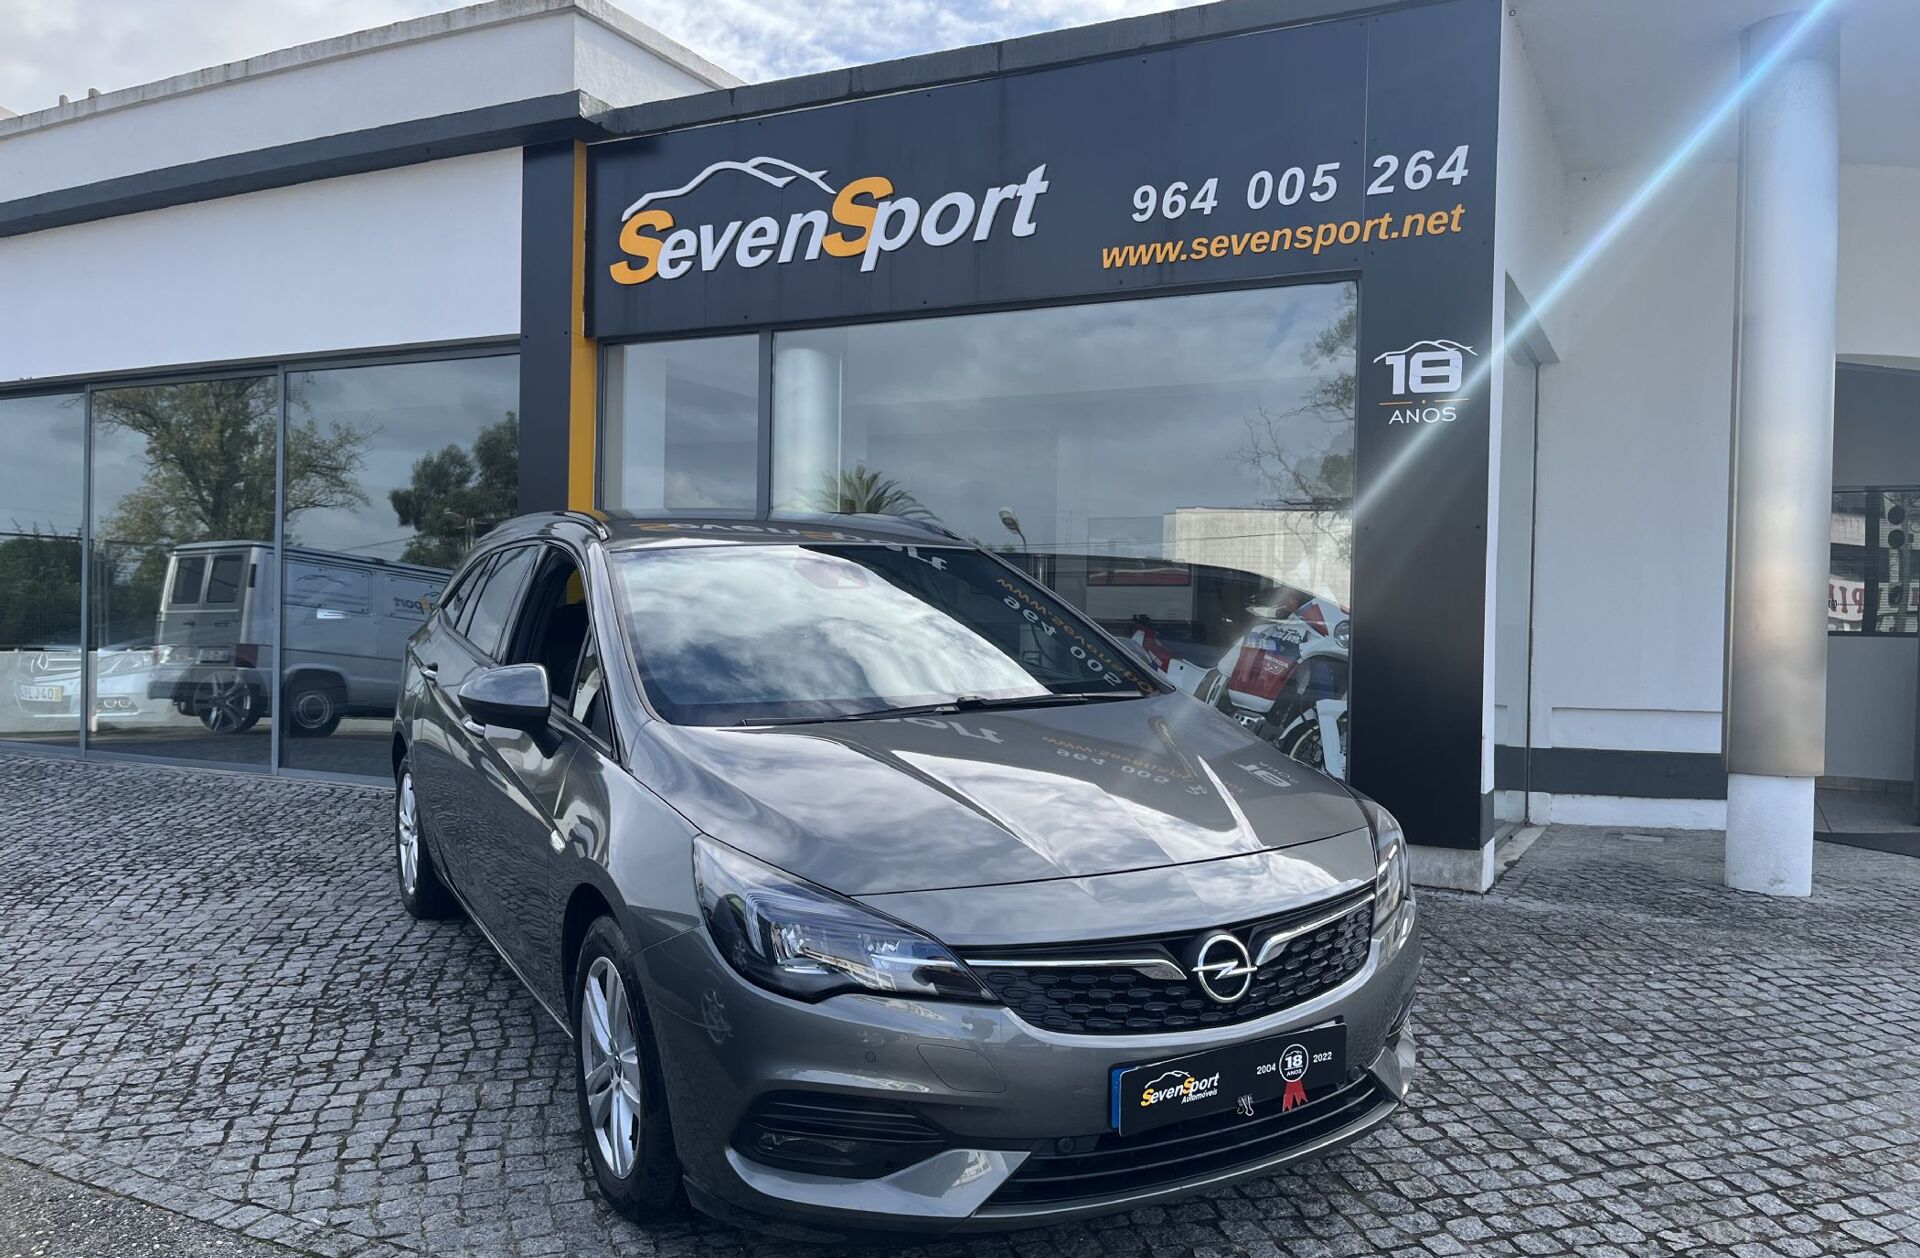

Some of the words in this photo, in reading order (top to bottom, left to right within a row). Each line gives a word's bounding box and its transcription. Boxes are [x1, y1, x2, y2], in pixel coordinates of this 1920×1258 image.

[1131, 177, 1219, 223] 964
[1246, 162, 1341, 210] 005
[1366, 145, 1470, 196] 264
[609, 163, 1050, 285] SevenSport
[1102, 203, 1465, 269] www.sevensport.net
[1385, 351, 1463, 395] 18
[1388, 407, 1457, 424] ANOS
[1256, 1062, 1276, 1075] 2004
[1285, 1054, 1303, 1068] 18
[1313, 1051, 1333, 1063] 2022
[1140, 1072, 1220, 1107] SevenSport
